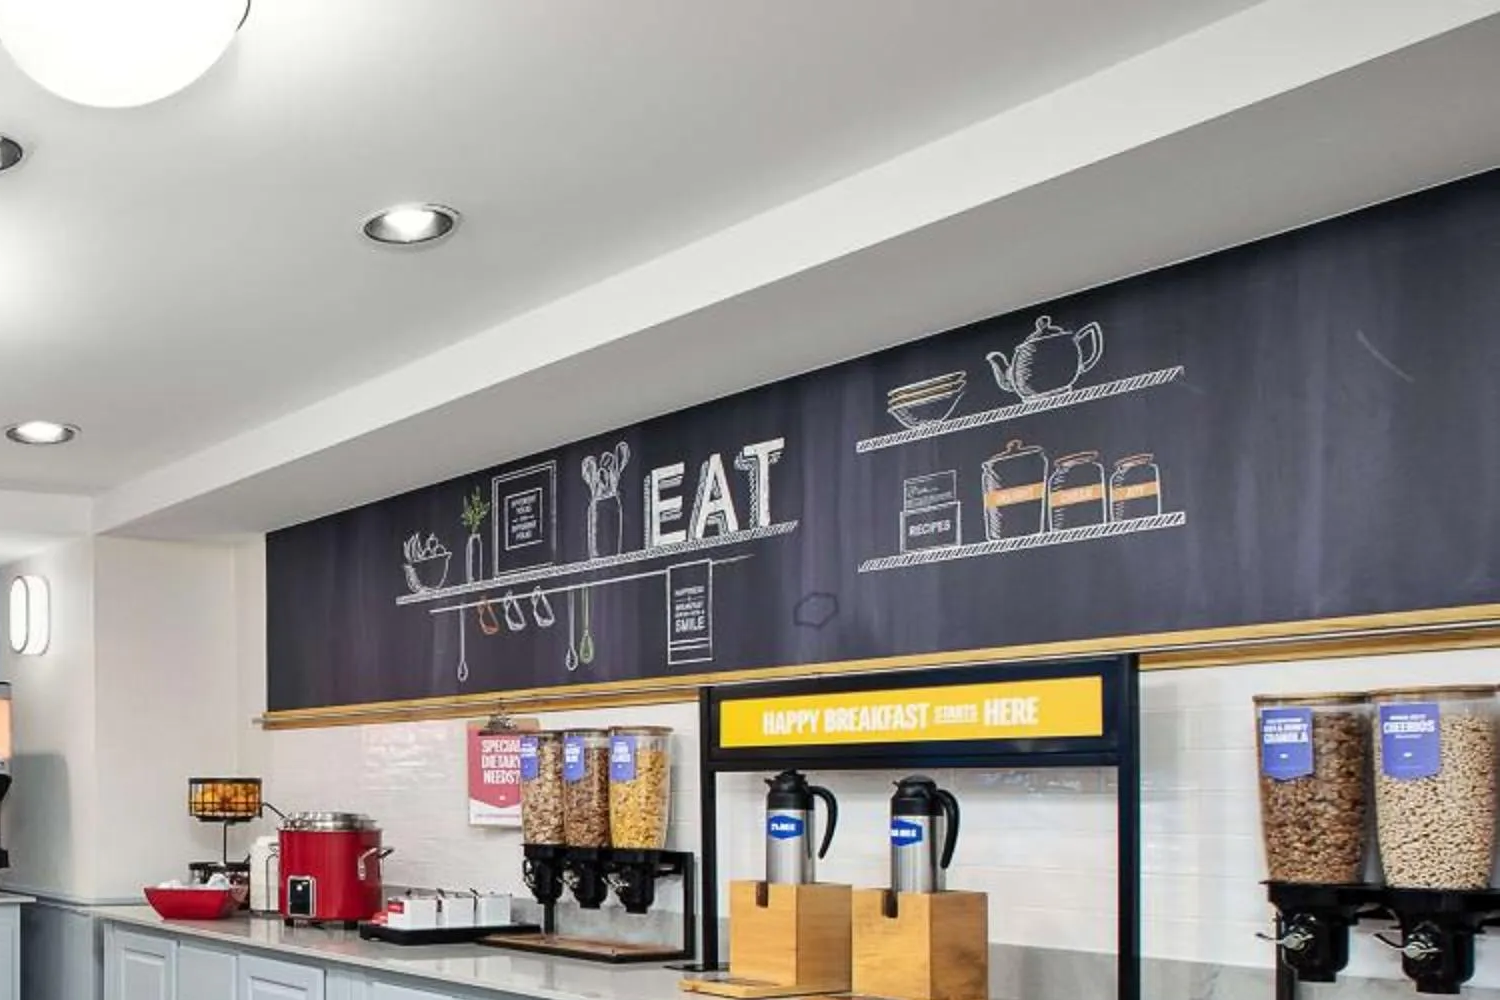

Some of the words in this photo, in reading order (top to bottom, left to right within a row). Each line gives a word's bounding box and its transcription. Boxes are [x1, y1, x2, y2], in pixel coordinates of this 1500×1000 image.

[644, 437, 785, 549] EAT
[909, 519, 951, 536] RECIPES
[763, 710, 821, 736] HAPPY
[823, 703, 930, 734] BREAKFAST
[984, 697, 1038, 727] HERE
[481, 739, 520, 753] SPECIAL
[481, 754, 520, 769] DIETARY
